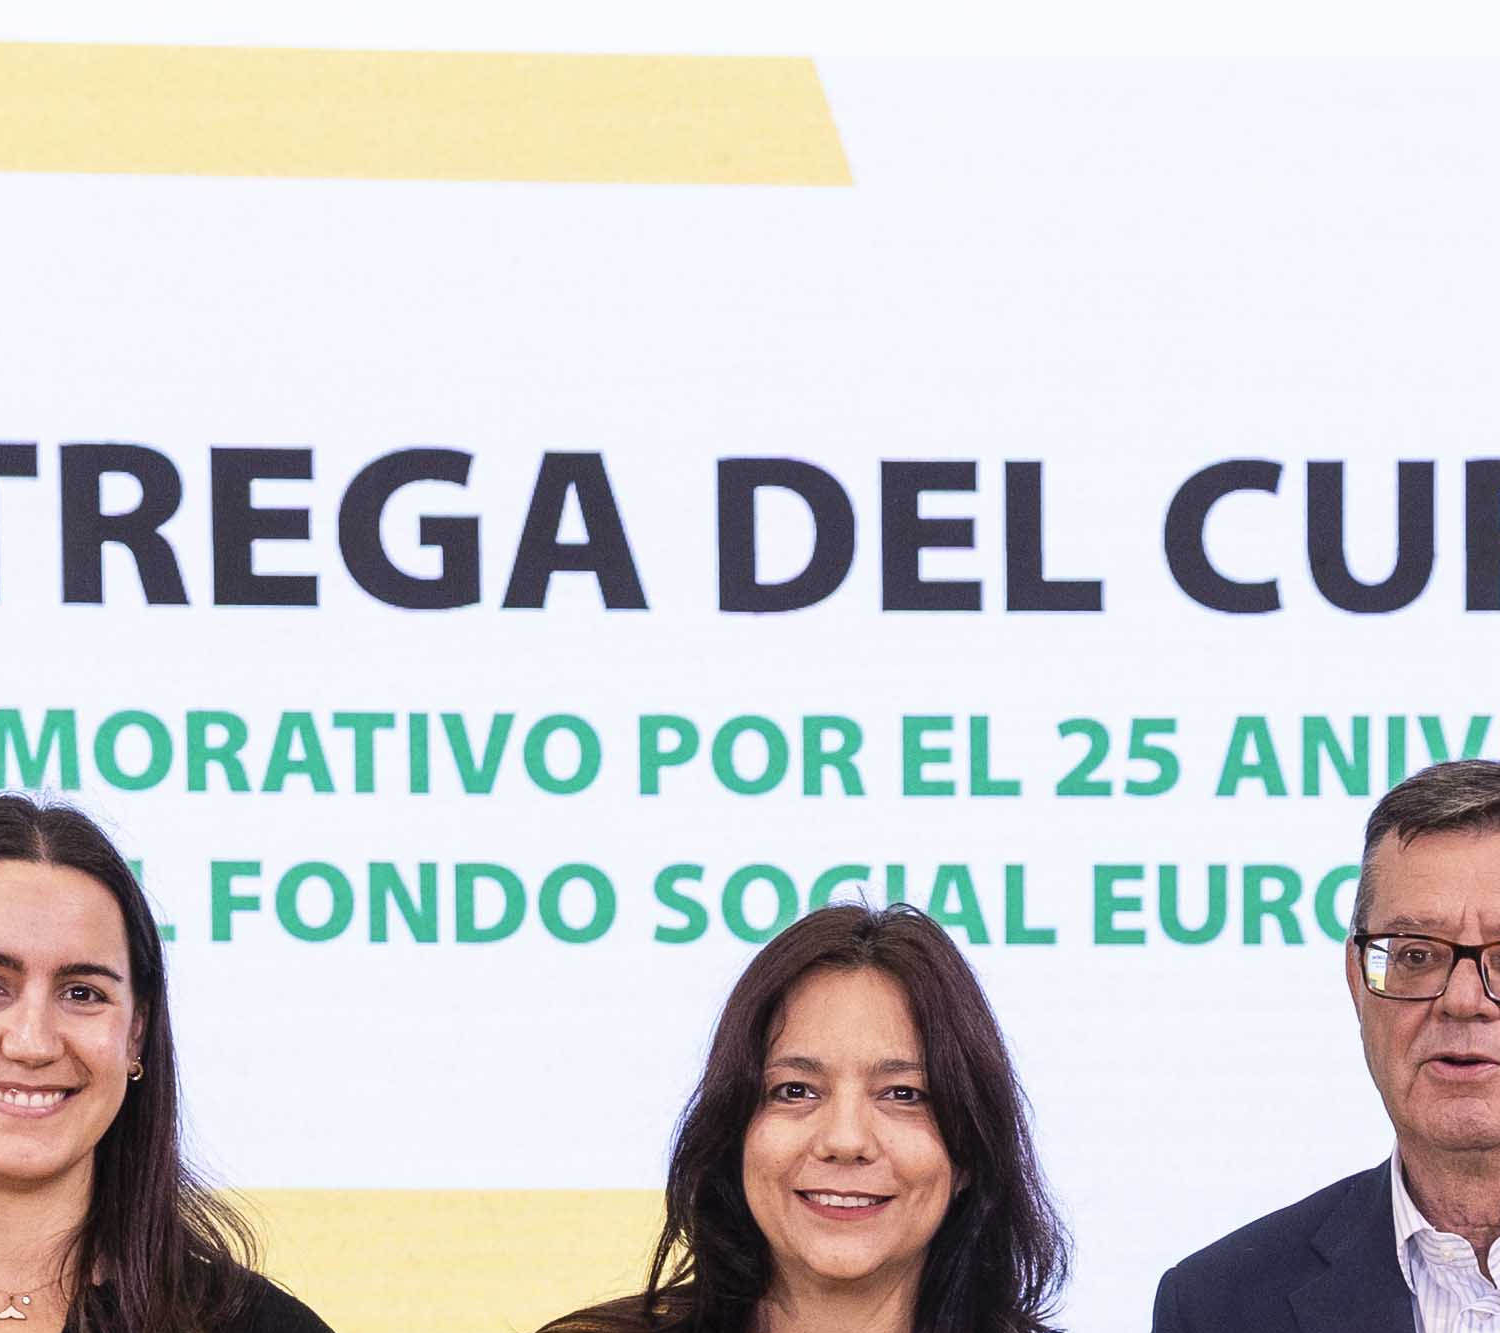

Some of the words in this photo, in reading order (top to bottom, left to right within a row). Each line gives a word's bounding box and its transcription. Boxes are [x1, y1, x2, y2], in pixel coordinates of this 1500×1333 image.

[716, 456, 1103, 614] DEL
[638, 714, 867, 797] POR
[902, 715, 1023, 797] EL
[1055, 717, 1181, 797] 25
[210, 859, 617, 944] FONDO
